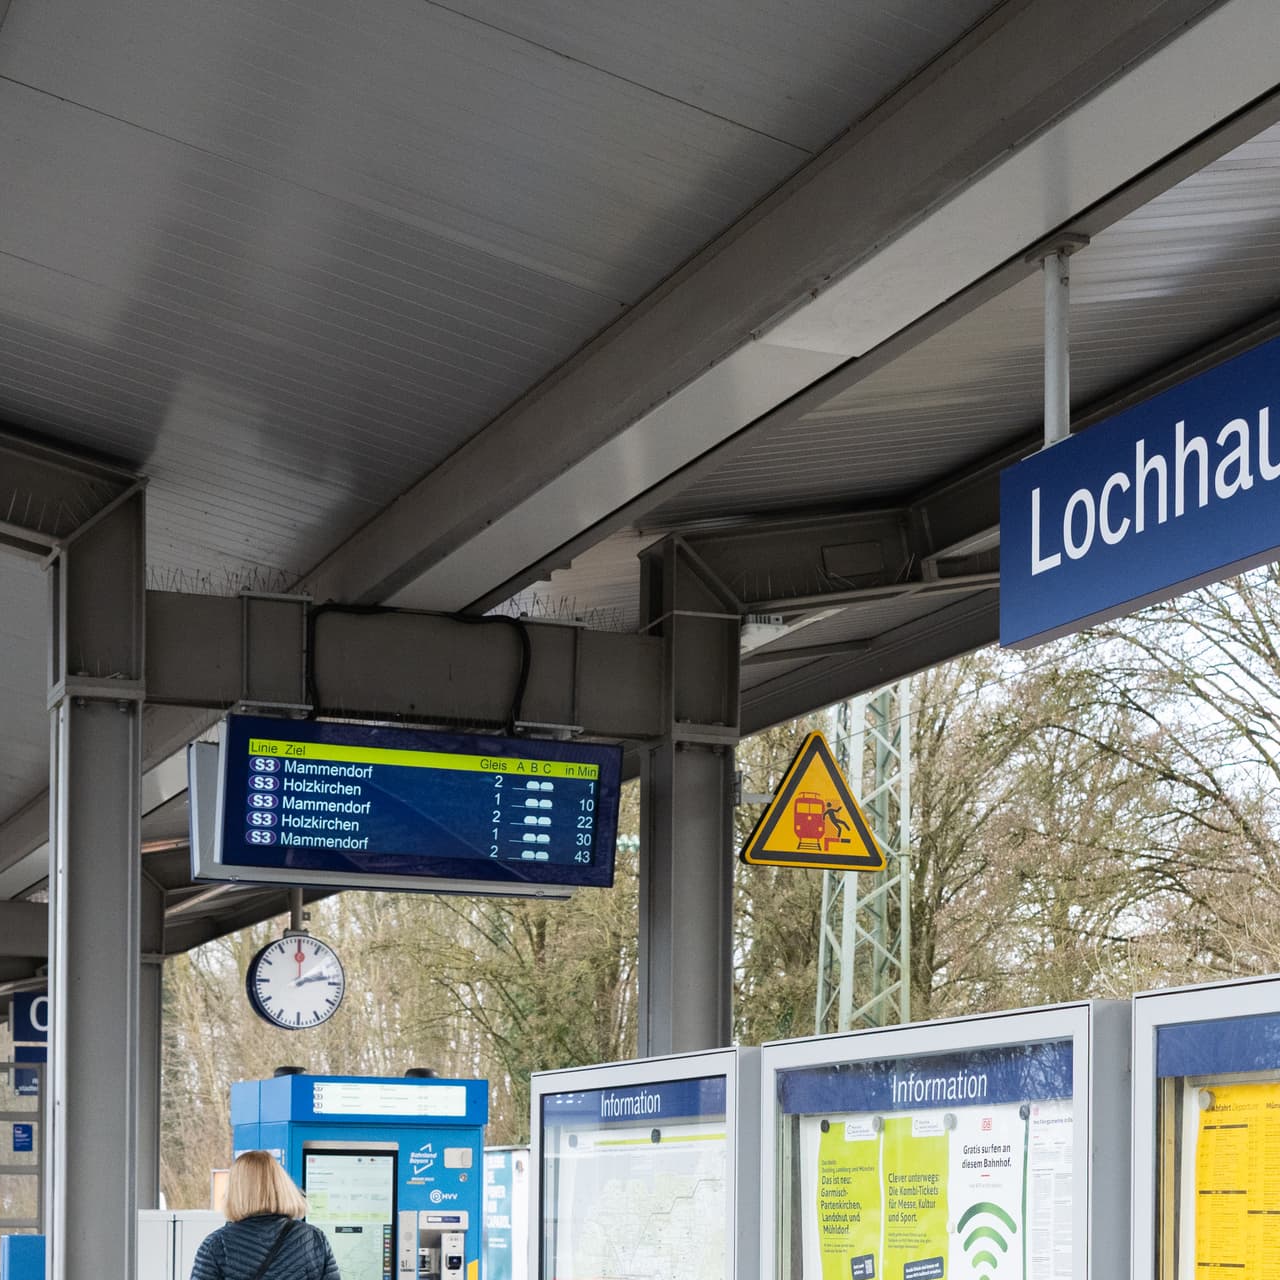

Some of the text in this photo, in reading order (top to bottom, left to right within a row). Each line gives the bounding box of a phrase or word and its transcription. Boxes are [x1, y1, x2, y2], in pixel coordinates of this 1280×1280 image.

[251, 742, 596, 776] Linie Ziel Gleis A B C in Min
[255, 759, 594, 794] S3 Mammendorf 2 1
[254, 777, 594, 811] S3 Holzkirchen 1 10
[253, 795, 592, 828] S3 Mammendorf 2 22
[252, 813, 591, 846] S3 Holzkirchen 1 30
[251, 831, 590, 863] S3 Mammendorf 2 43
[892, 1072, 987, 1103] Information
[601, 1093, 661, 1117] Information
[963, 1144, 1011, 1154] Gratis surfen an
[962, 1157, 1011, 1168] diesem Bahnhof.
[822, 1176, 832, 1184] Das
[888, 1173, 939, 1184] Clever unterwegs:
[821, 1189, 848, 1197] Garmisch-
[889, 1186, 939, 1196] Die Kombi-Tickets
[821, 1201, 862, 1210] Partenkirchen,
[919, 1199, 935, 1208] Kultur
[822, 1212, 860, 1222] Landshut und
[889, 1213, 917, 1224] und Sport.
